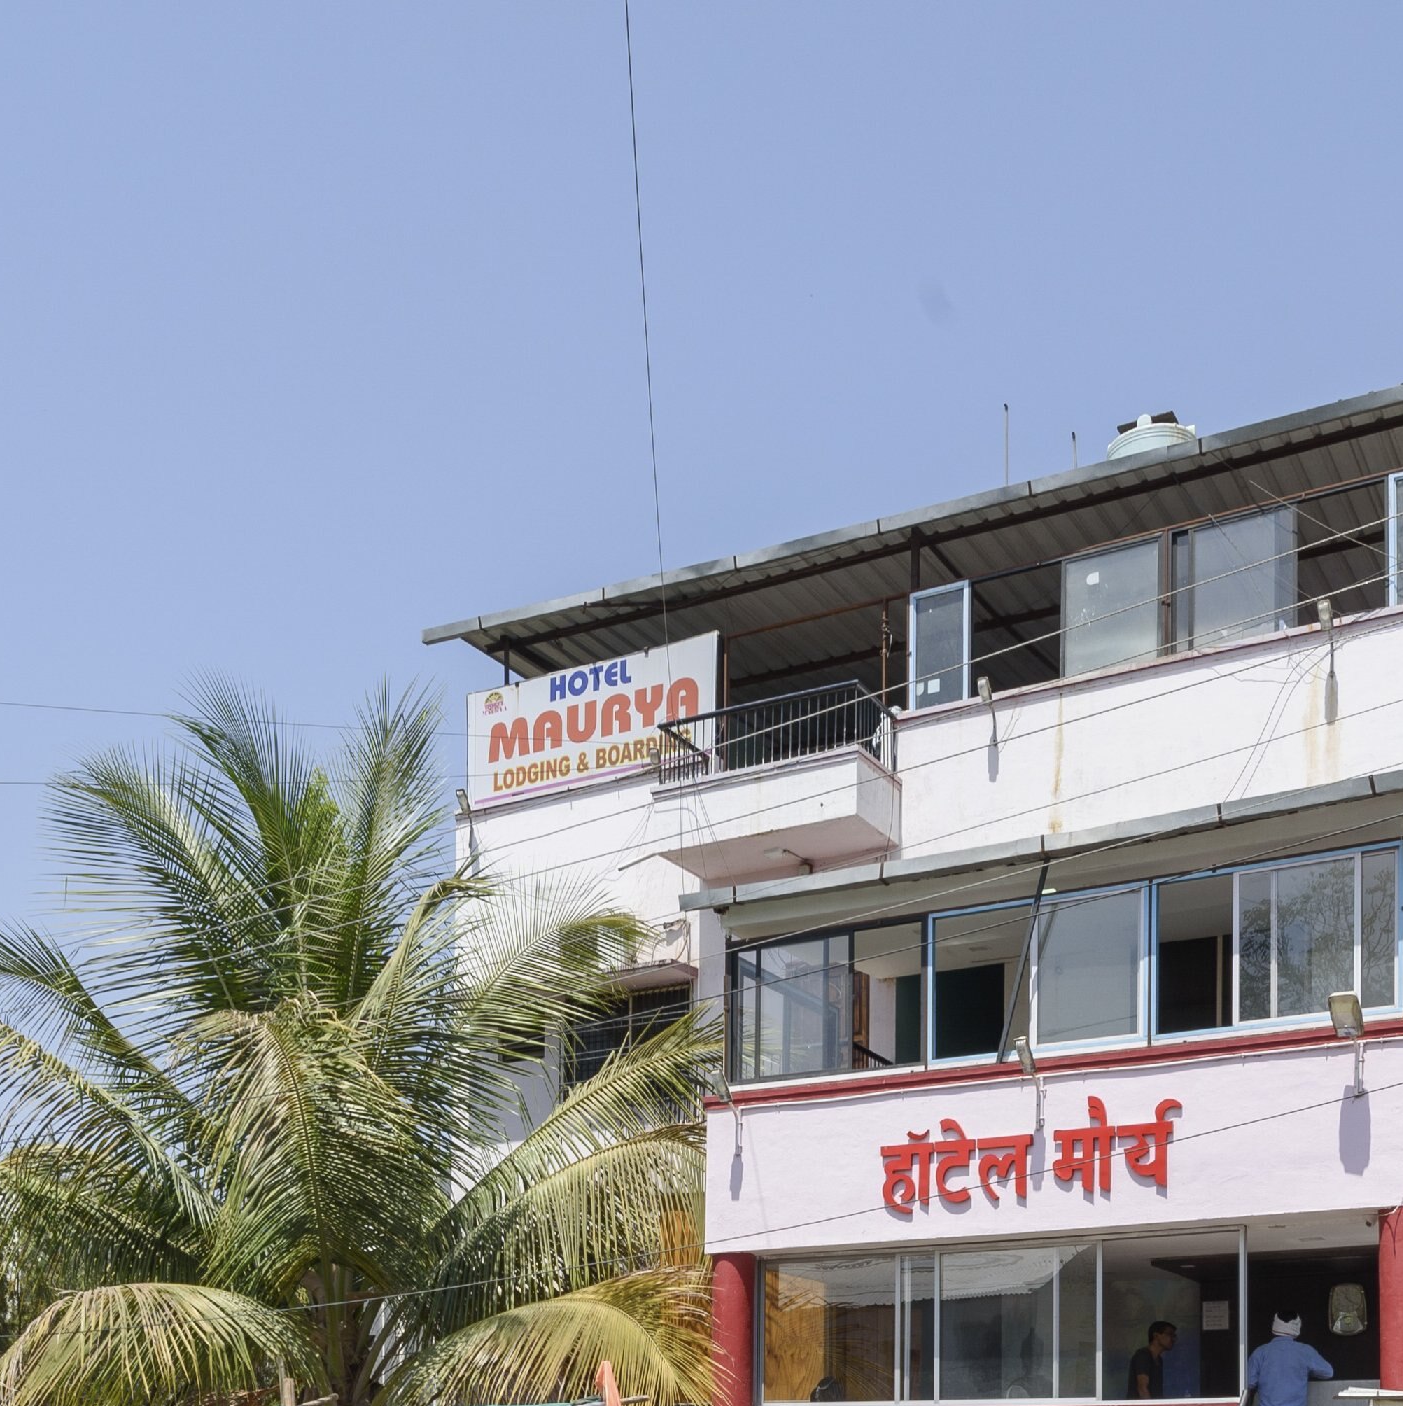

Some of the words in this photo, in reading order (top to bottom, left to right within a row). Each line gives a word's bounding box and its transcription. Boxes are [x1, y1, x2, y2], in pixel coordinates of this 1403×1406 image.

[550, 659, 632, 702] HOTEL
[488, 677, 700, 763] MAURYA
[493, 756, 571, 792] LODGING
[577, 752, 589, 773] &
[880, 1118, 1035, 1214] हॉटेल
